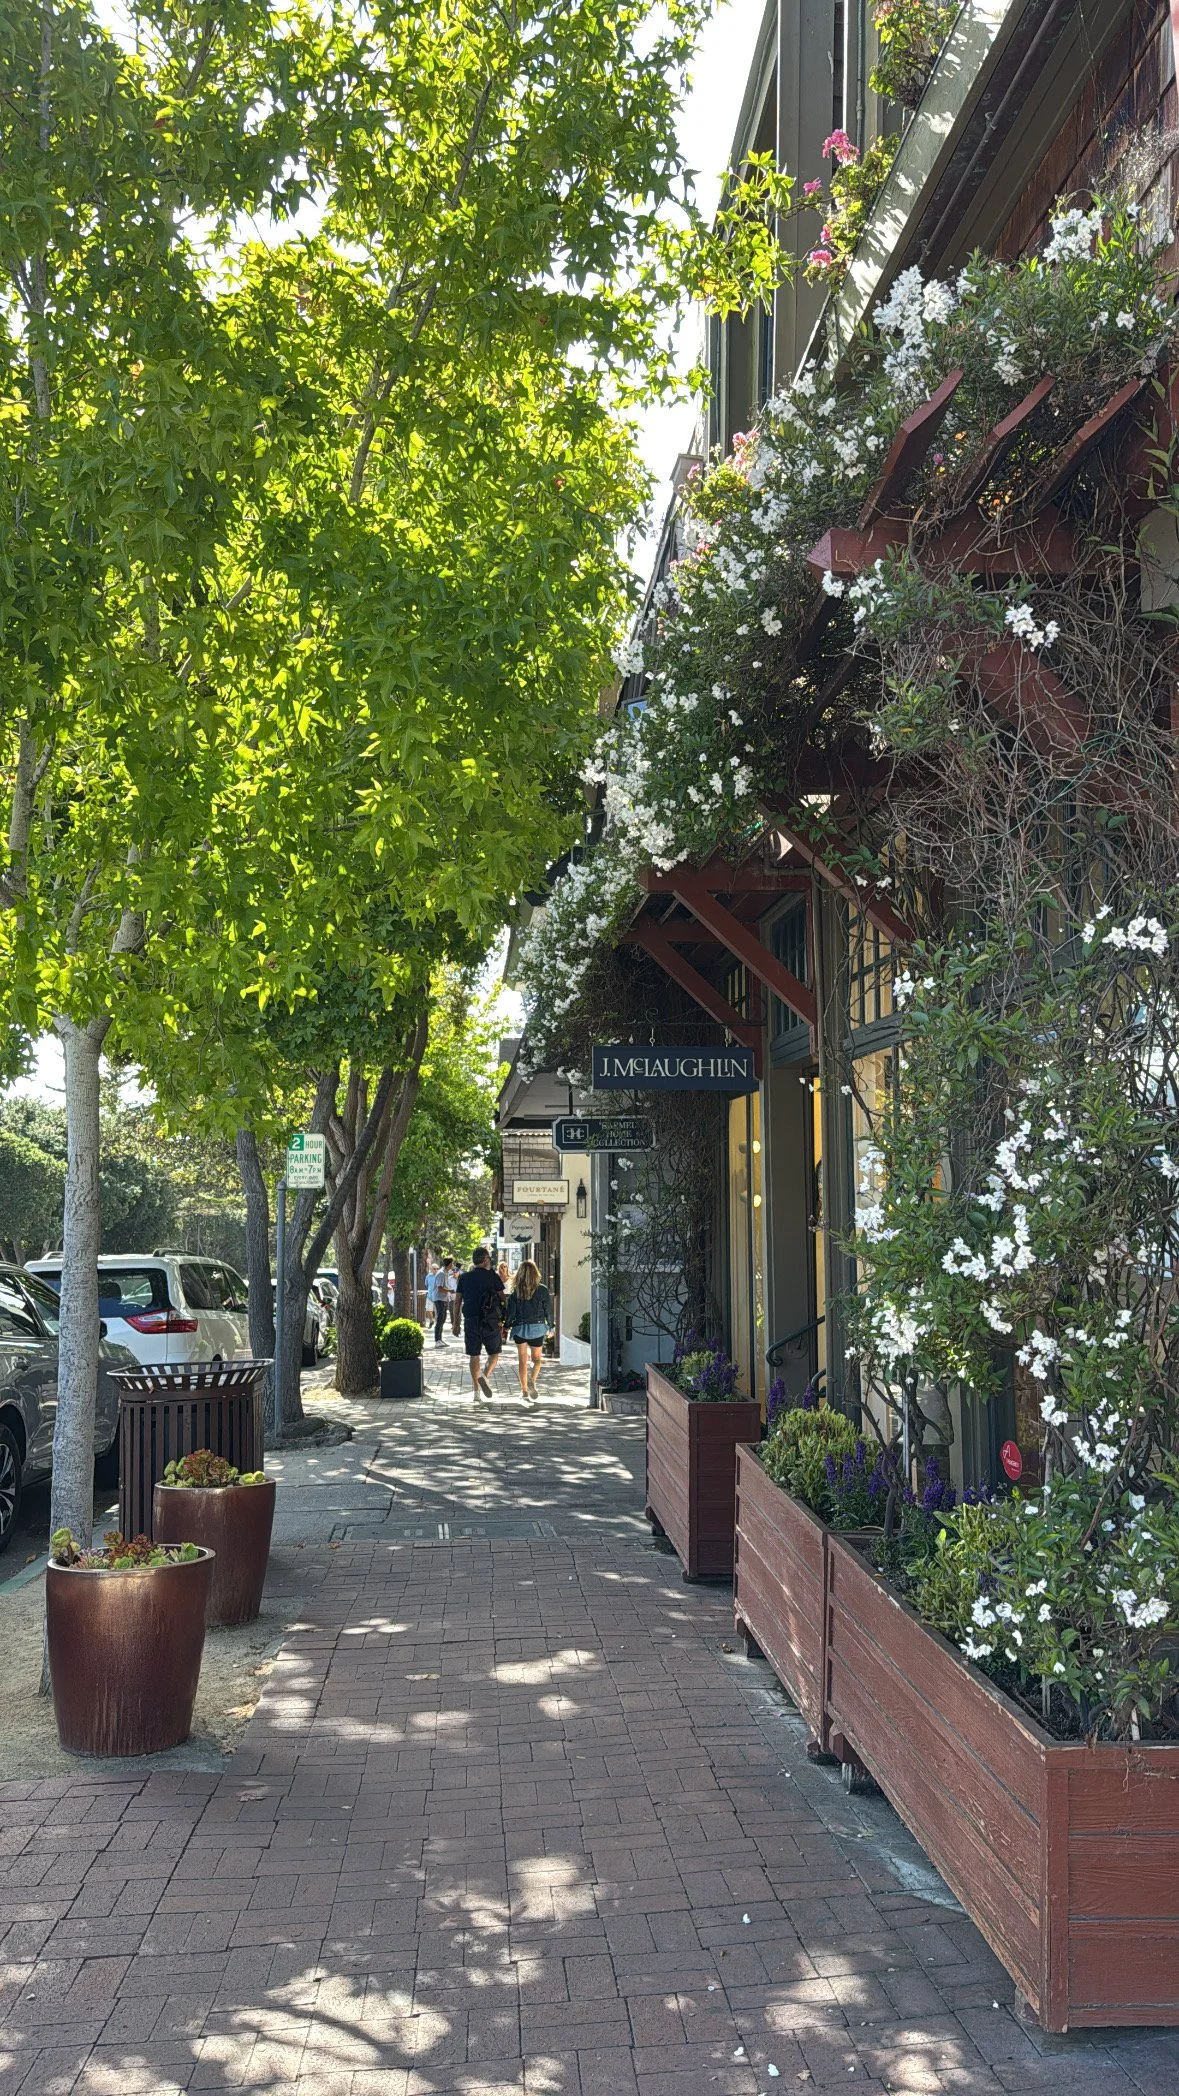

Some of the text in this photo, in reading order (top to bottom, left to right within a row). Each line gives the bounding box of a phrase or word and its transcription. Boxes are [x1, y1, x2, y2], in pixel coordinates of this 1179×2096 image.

[600, 1057, 611, 1077] J.
[292, 1137, 323, 1149] 2 HOUR
[290, 1154, 322, 1163] PARKING
